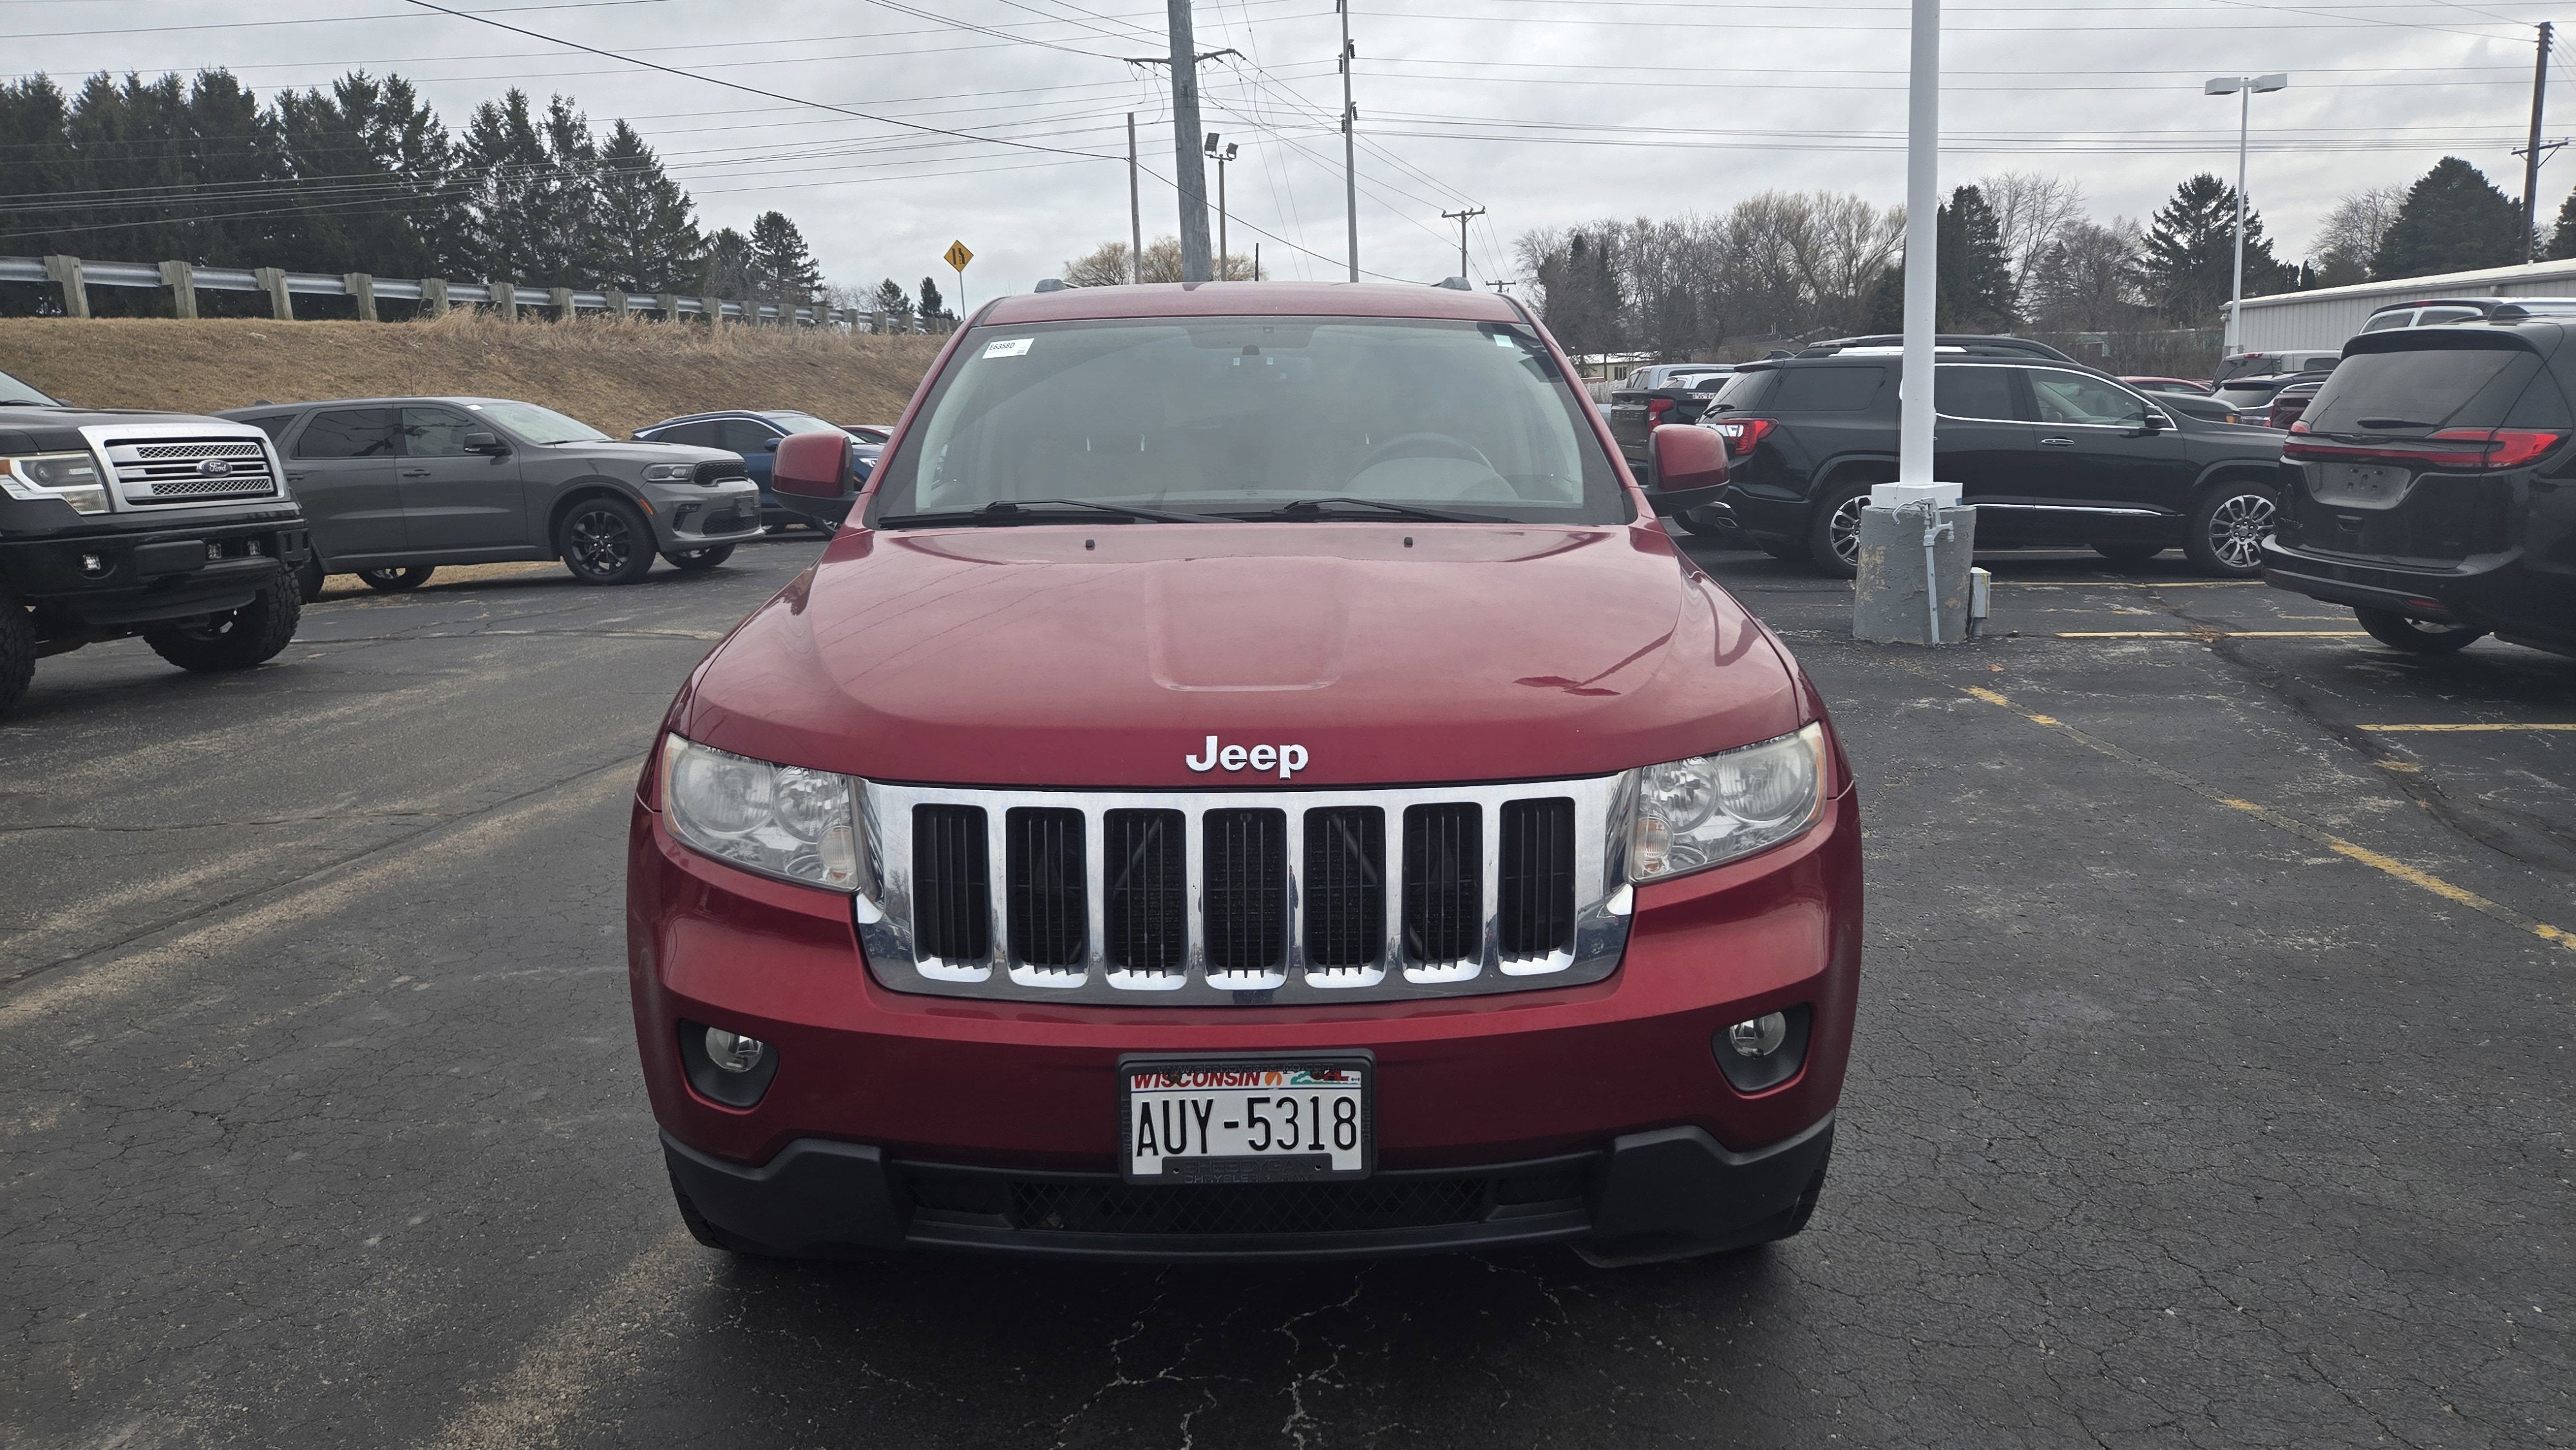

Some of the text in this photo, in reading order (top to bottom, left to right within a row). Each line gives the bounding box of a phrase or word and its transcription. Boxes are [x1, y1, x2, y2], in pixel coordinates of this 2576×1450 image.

[209, 462, 227, 472] Ford
[1186, 735, 1309, 780] Jeep
[1133, 1071, 1262, 1089] WISCONSIN
[1136, 1095, 1358, 1156] AUY-5318
[1183, 1158, 1311, 1173] SHEBOYGAN
[1184, 1174, 1259, 1184] CHRYSLER
